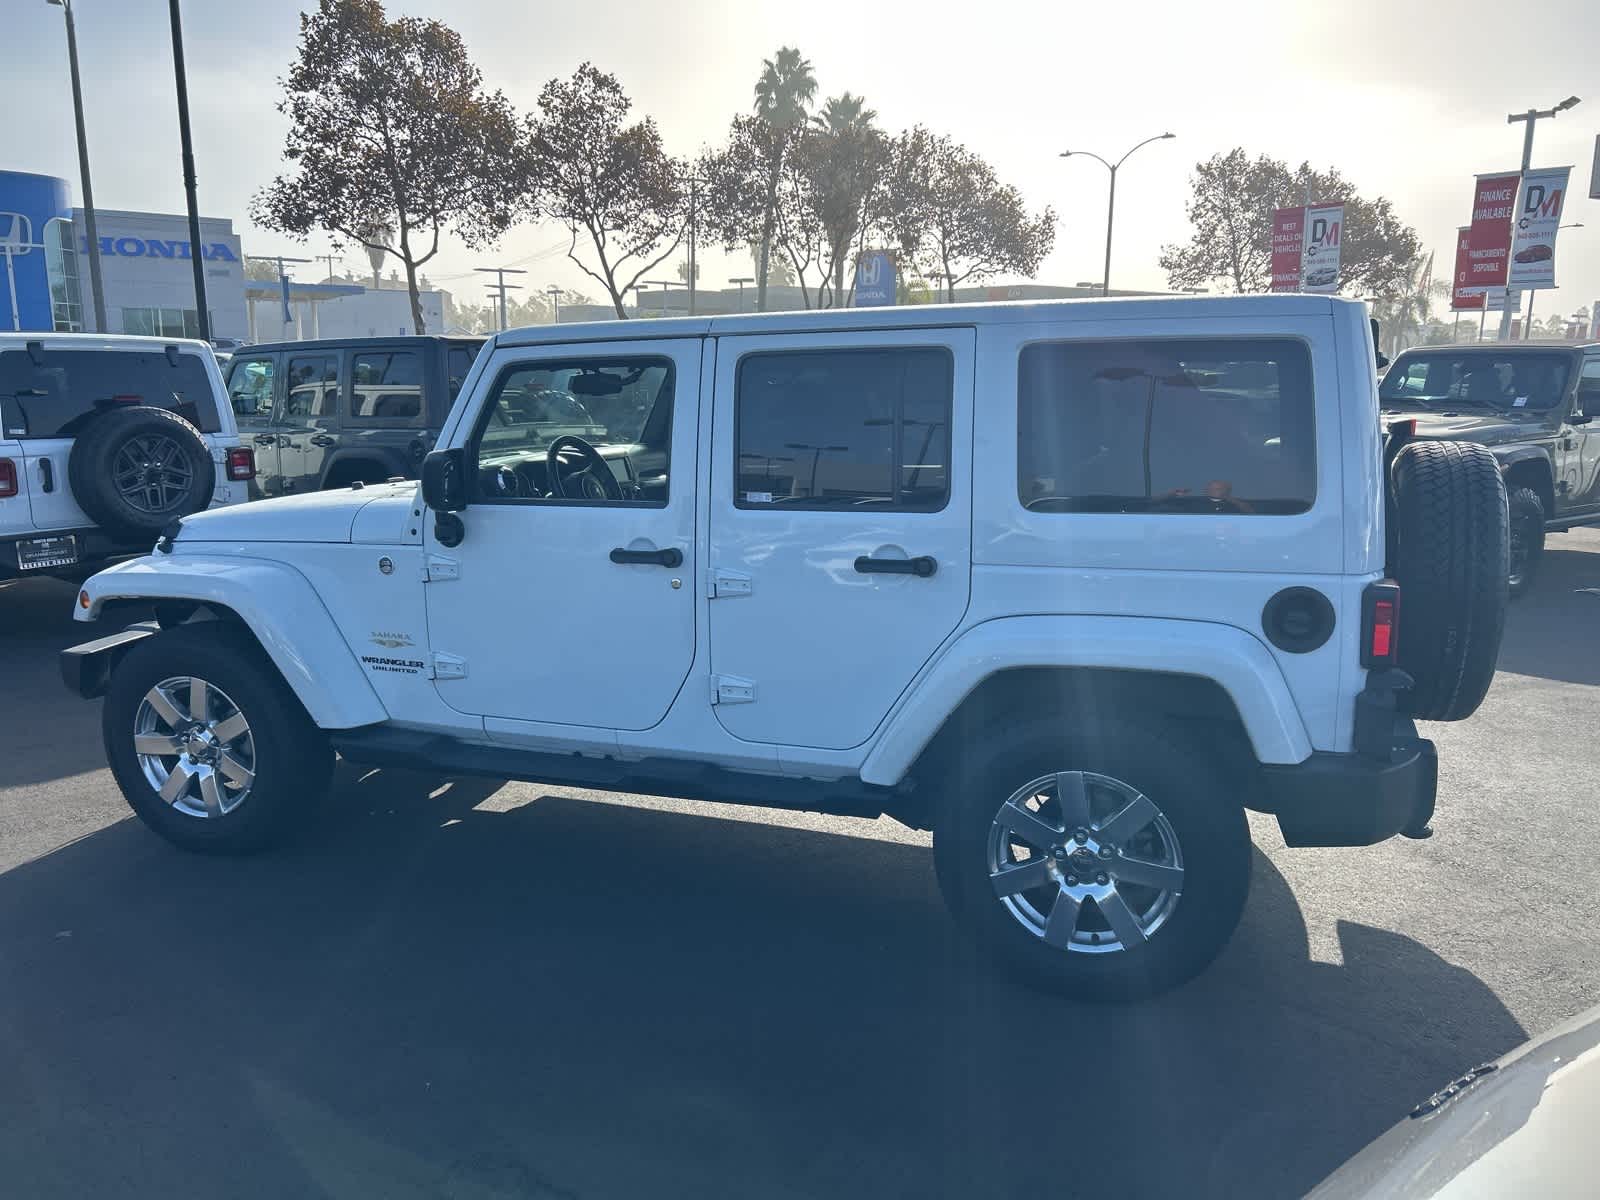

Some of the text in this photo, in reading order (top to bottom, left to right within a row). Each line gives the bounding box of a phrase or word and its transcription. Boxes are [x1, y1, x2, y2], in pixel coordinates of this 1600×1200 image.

[1480, 188, 1512, 202] FINANCE
[1473, 206, 1512, 220] AVAILABLE
[80, 235, 239, 262] HONDA
[371, 631, 412, 641] SAHARA
[361, 656, 424, 669] WRANGLER
[372, 665, 419, 674] UNLIMITED
